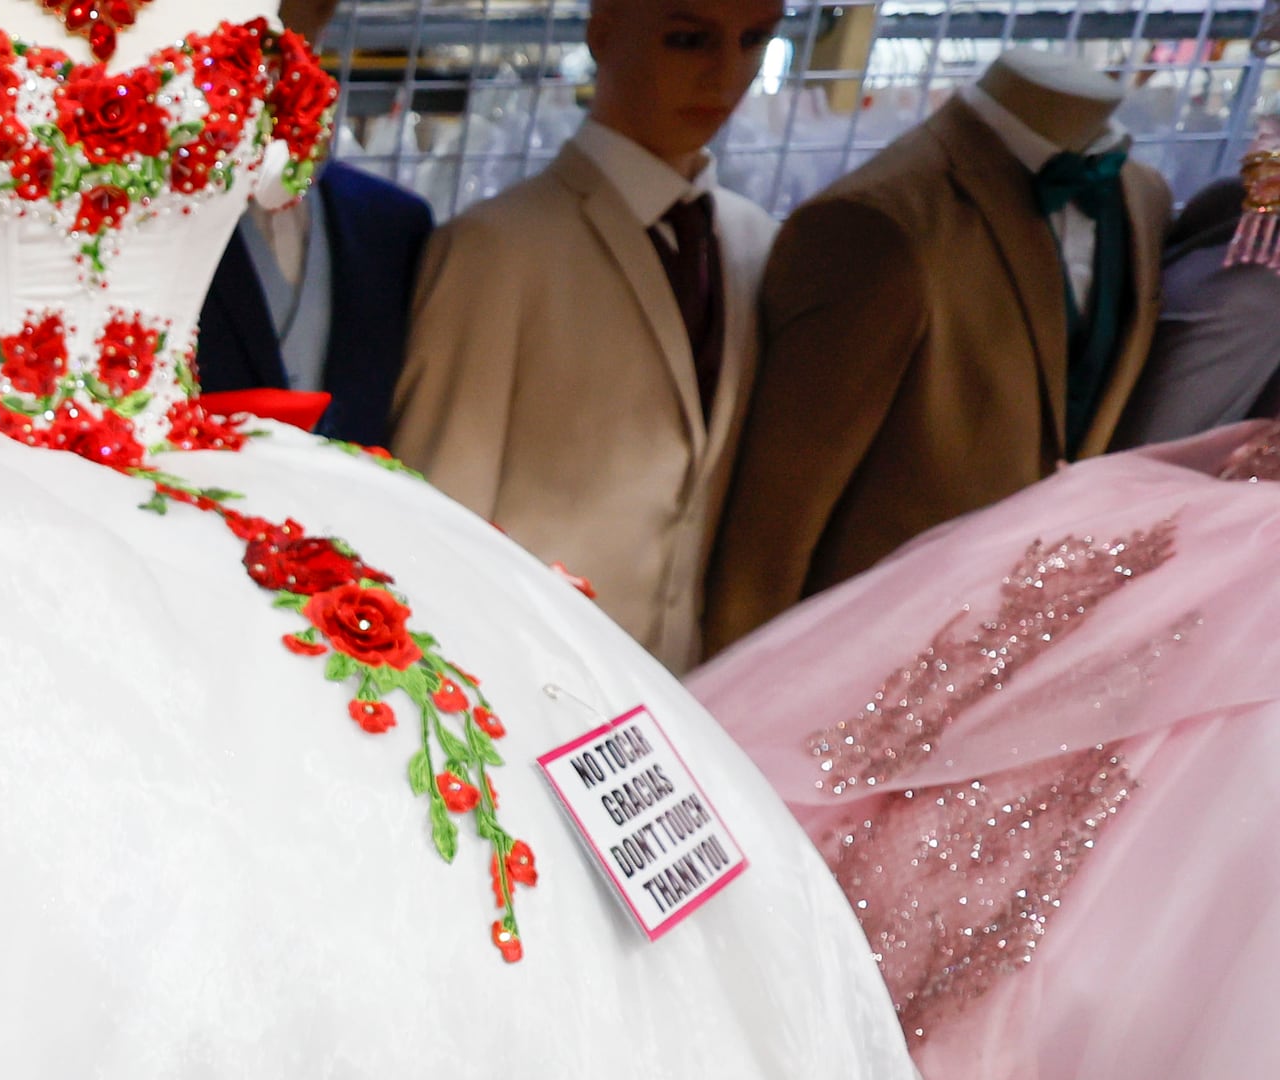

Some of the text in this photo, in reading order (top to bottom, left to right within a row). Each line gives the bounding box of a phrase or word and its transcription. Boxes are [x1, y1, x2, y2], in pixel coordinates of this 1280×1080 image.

[570, 726, 653, 789] NO TOCAR
[601, 764, 675, 826] GRACIAS
[610, 794, 712, 879] DON'T TOUCH
[643, 834, 730, 914] THANK YOU
